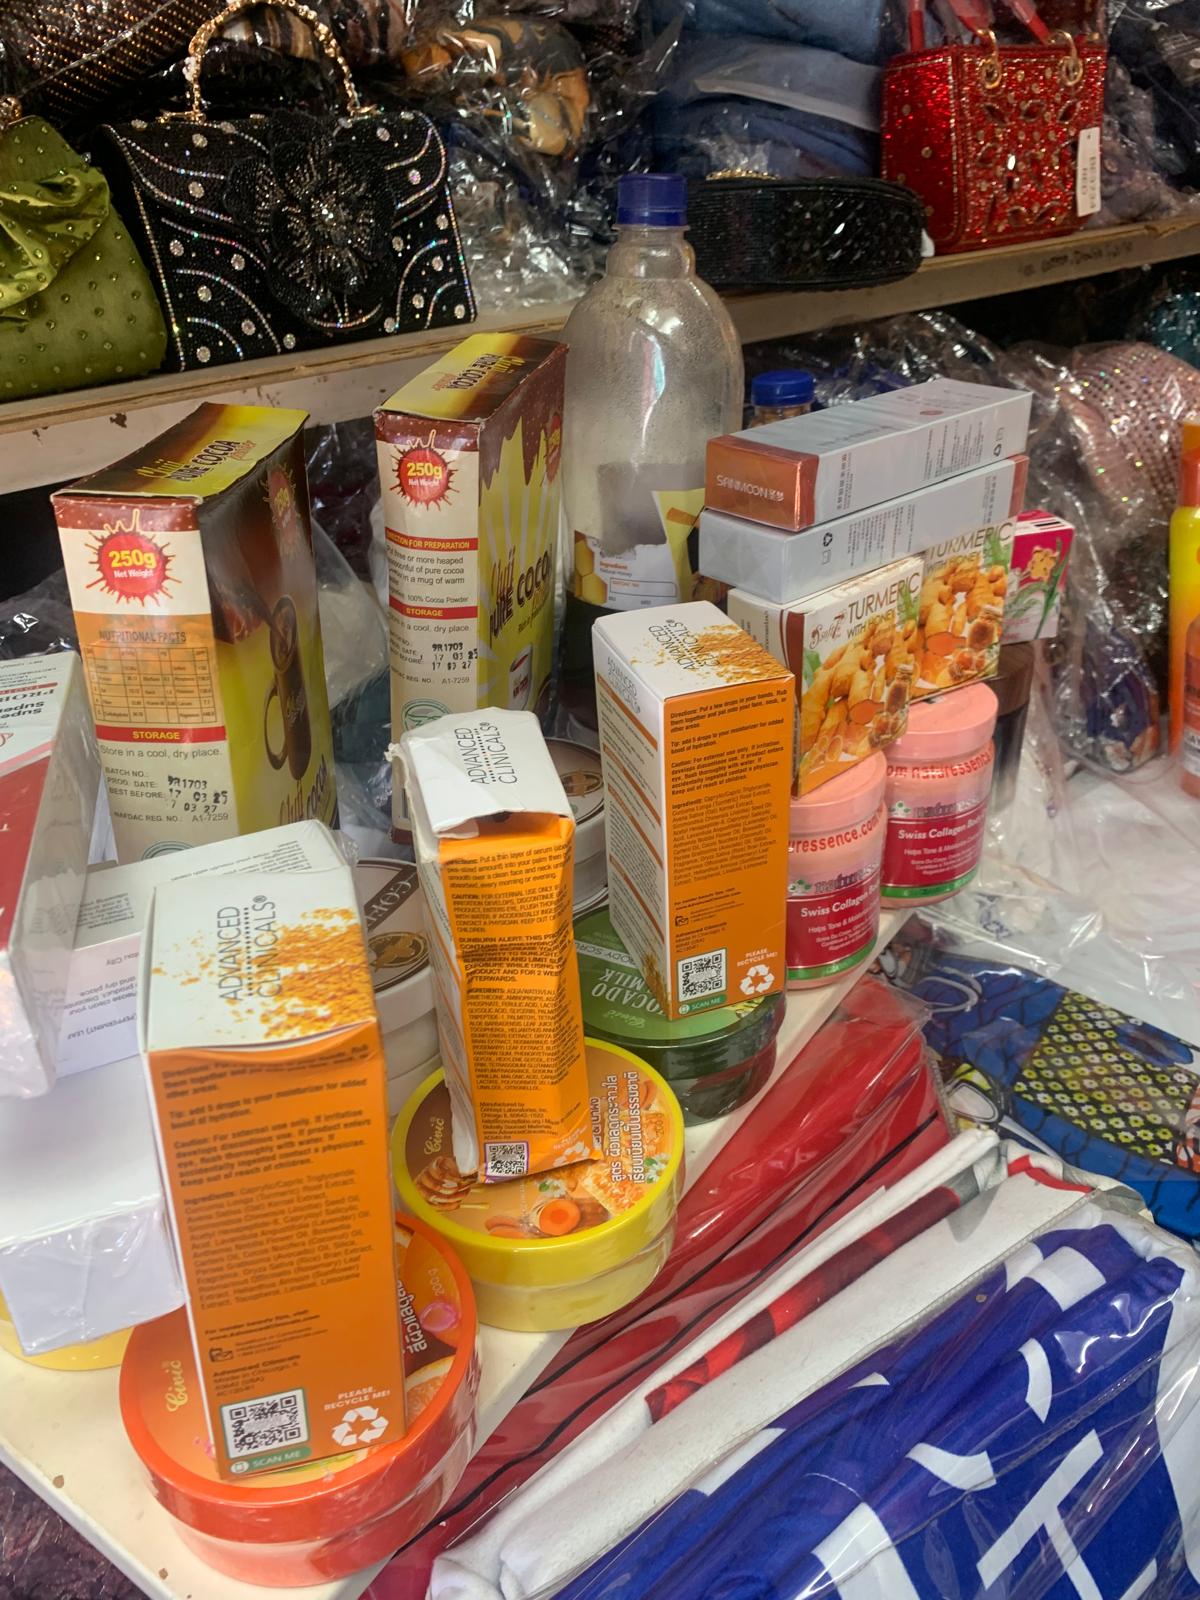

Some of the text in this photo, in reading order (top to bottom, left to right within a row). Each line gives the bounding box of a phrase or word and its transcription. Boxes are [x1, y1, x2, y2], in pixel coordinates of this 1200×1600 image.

[446, 368, 486, 390] COCOA
[192, 440, 240, 466] COCOA
[407, 463, 442, 480] 250g
[716, 474, 768, 499] SANMOON
[409, 540, 470, 549] FOR PREPARATION
[109, 548, 157, 569] 250g
[436, 556, 464, 566] heaped
[114, 568, 154, 578] Net Weight
[424, 568, 441, 576] pure
[443, 567, 465, 575] cocoa
[417, 577, 434, 586] mug
[425, 596, 445, 604] Cocoa
[446, 596, 469, 604] Powder
[848, 572, 920, 623] TURMERIC
[405, 608, 443, 617] STORAGE
[433, 624, 446, 634] dry
[847, 622, 867, 639] WITH
[99, 630, 187, 643] NUTRITIONAL FACTS
[648, 625, 699, 671] ADVANCED
[441, 676, 470, 684] A1-7259
[132, 731, 181, 740] STORAGE
[100, 745, 123, 757] Store
[126, 749, 135, 757] in
[146, 748, 171, 760] cool,
[172, 748, 189, 760] dry
[454, 727, 489, 785] ADVANCED
[480, 722, 518, 784] CLINICALS®
[105, 767, 131, 777] BATCH
[109, 787, 128, 797] BEST
[130, 789, 166, 799] BEFORE:
[193, 791, 207, 802] 03
[184, 802, 217, 815] 03 27
[191, 812, 229, 823] A1-7259
[898, 823, 966, 839] Swiss Collagen
[904, 848, 922, 856] Helps
[923, 847, 937, 855] Tone
[801, 890, 869, 918] Swiss Collagen
[808, 925, 826, 933] Helps
[827, 921, 842, 930] Tone
[252, 894, 282, 998] CLINICALS®
[745, 948, 767, 958] PLEASE
[217, 906, 243, 1001] ADVANCED
[737, 954, 762, 968] RECYCLE
[502, 968, 519, 976] AND
[520, 968, 536, 976] FOR
[119, 976, 136, 986] and
[598, 967, 647, 992] MILK
[592, 983, 667, 1017] OCADO
[691, 998, 722, 1010] SCAN ME
[340, 1078, 368, 1089] added
[165, 1359, 189, 1413] Civic
[338, 1385, 376, 1400] PLEASE
[324, 1390, 391, 1412] RECYCLE ME!
[251, 1450, 301, 1468] SCAN ME
